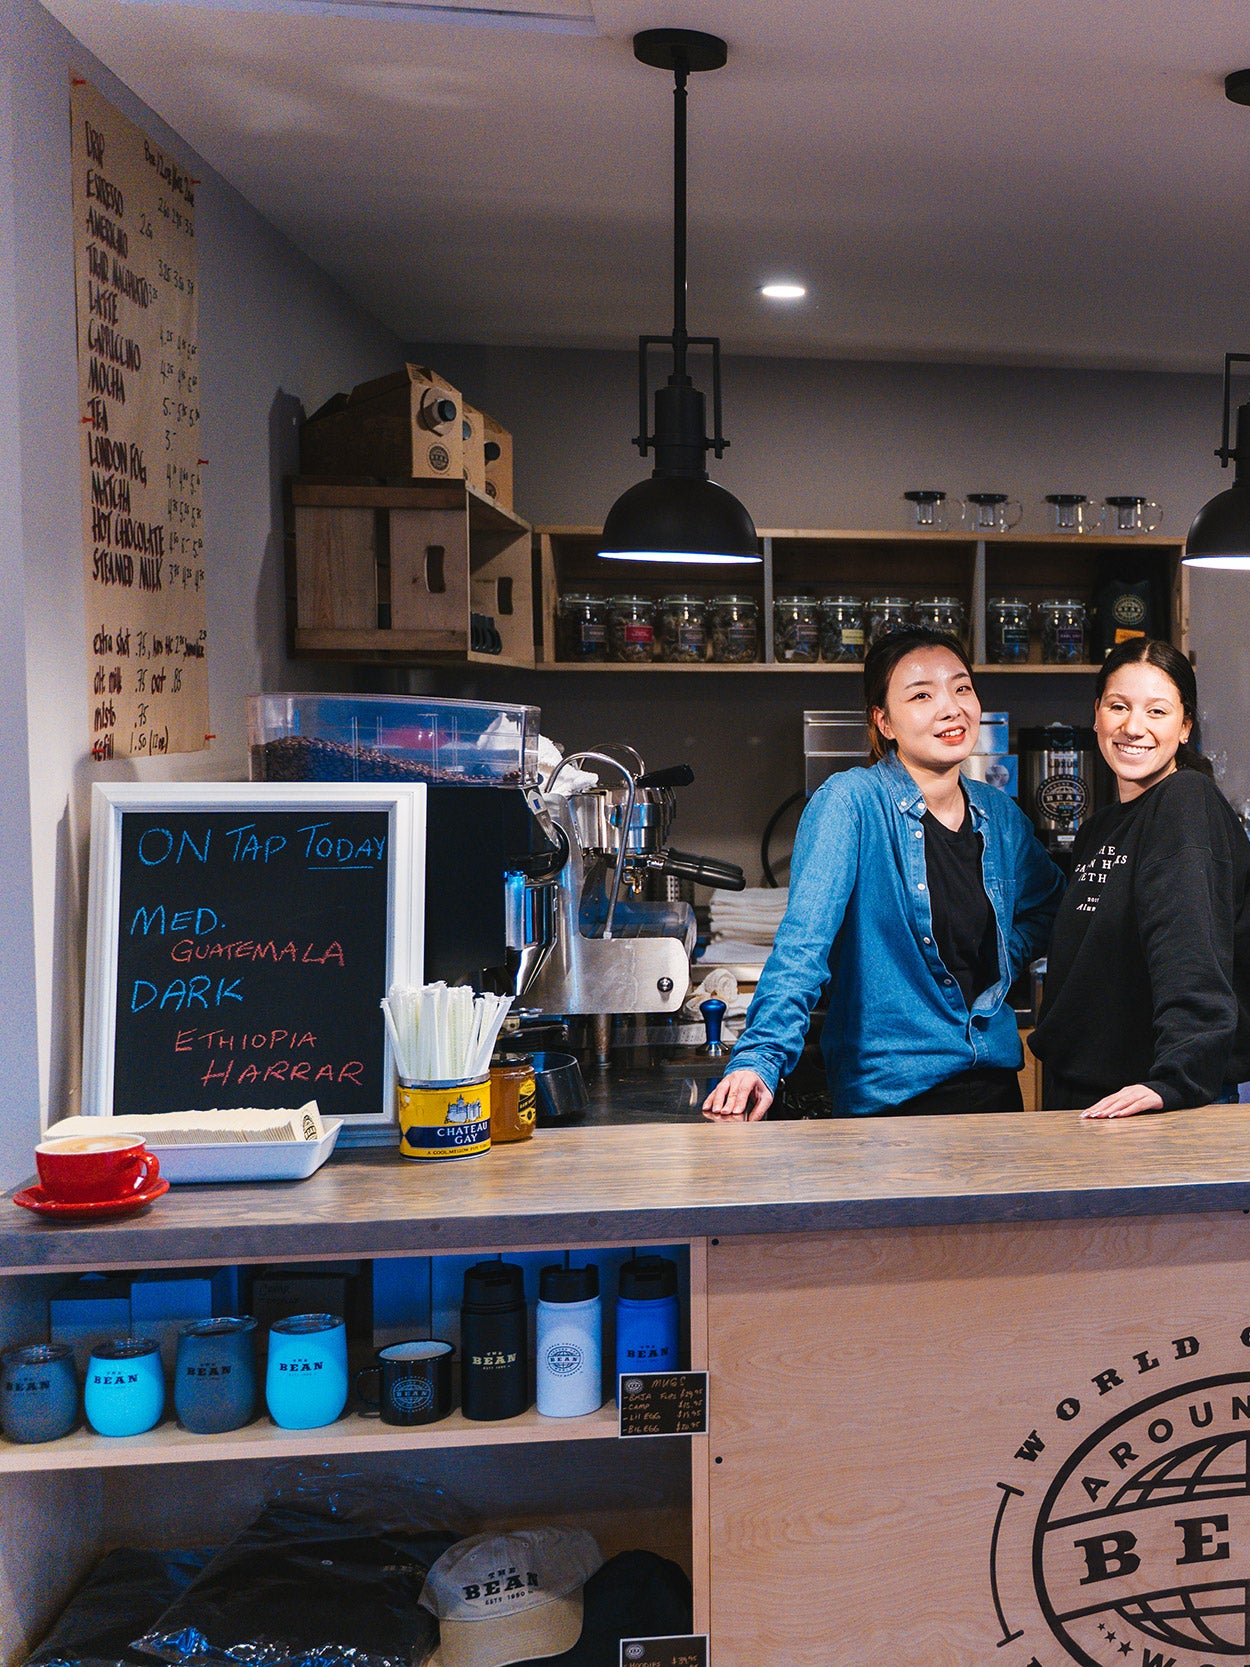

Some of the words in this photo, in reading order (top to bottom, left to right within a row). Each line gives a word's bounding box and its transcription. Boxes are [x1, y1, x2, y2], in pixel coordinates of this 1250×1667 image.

[88, 280, 118, 327] LATTE
[88, 356, 125, 405] MOCHA
[87, 396, 108, 432] TEA
[87, 431, 128, 477] LONDON
[129, 442, 147, 492] FOG
[92, 506, 113, 549] HOT
[115, 512, 165, 558] CHOCOLATE
[92, 547, 134, 589] STEAMED
[139, 556, 163, 593] MILK
[138, 828, 212, 866] ON
[225, 823, 287, 864] TAP
[297, 822, 386, 863] TODAY
[130, 905, 226, 936] MED.
[170, 939, 345, 967] GUATEMALA
[131, 975, 244, 1014] DARK
[175, 1028, 317, 1052] ETHIOPIA
[201, 1059, 365, 1087] HARRAR
[437, 1121, 488, 1137] CHATEAU
[454, 1133, 478, 1145] GAY
[279, 1362, 323, 1372] BEAN
[472, 1353, 517, 1366] BEAN
[627, 1347, 669, 1359] BEAN
[94, 1374, 138, 1385] BEAN
[187, 1365, 231, 1376] BEAN
[651, 1376, 686, 1388] MUGS
[6, 1380, 50, 1391] BEAN
[1014, 1335, 1200, 1465] WORLD
[462, 1571, 539, 1600] BEAN
[488, 1567, 516, 1579] THE
